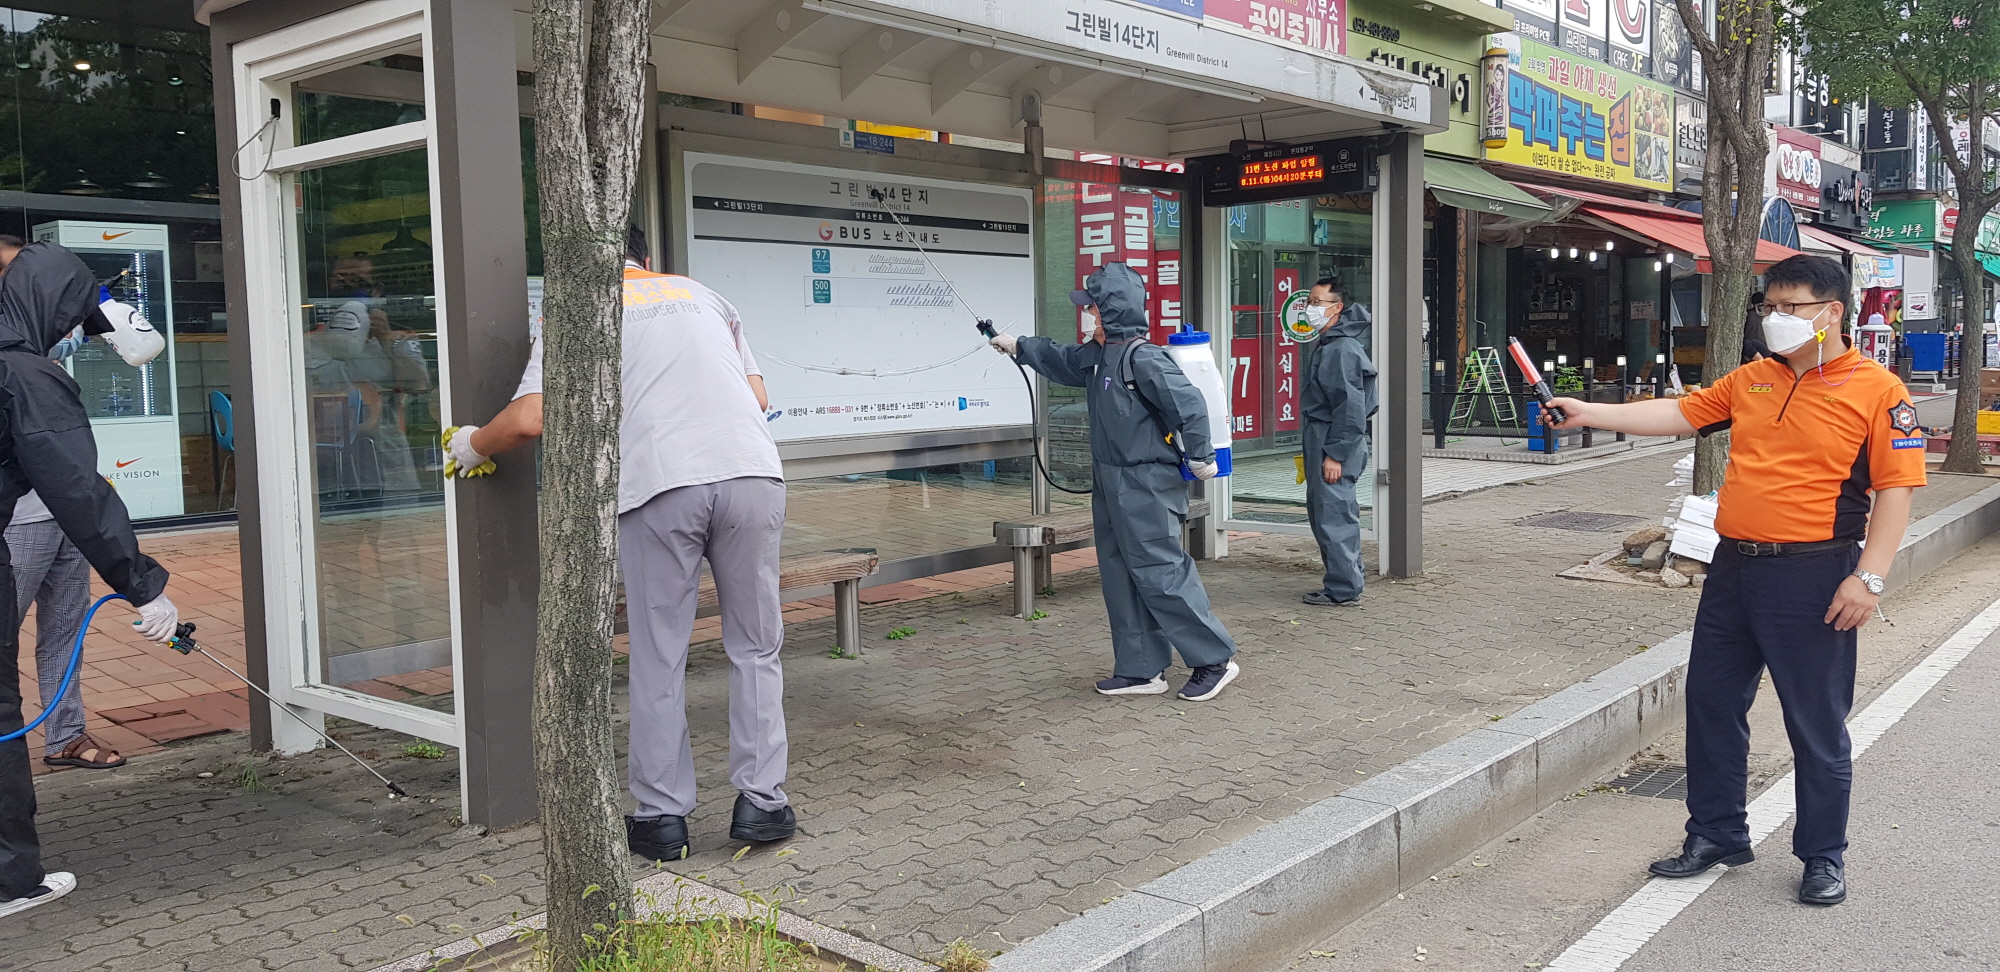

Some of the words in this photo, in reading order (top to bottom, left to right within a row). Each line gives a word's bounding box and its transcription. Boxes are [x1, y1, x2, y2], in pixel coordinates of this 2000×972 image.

[1065, 9, 1159, 55] 그린빌14단지
[1248, 1, 1340, 54] 공인중개사
[1166, 46, 1195, 62] Greenvill
[1197, 54, 1219, 67] District
[1221, 60, 1228, 69] 14
[1613, 49, 1628, 68] CAFE
[1631, 52, 1643, 74] 2F
[1548, 56, 1571, 87] 과일
[1573, 64, 1595, 95] 야채
[1598, 70, 1618, 100] 생선
[1509, 72, 1605, 162] 막퍼주는
[1608, 90, 1631, 167] 집
[1487, 127, 1505, 138] Shop
[868, 135, 894, 149] 18-244
[1245, 164, 1260, 174] 11번
[1264, 162, 1278, 172] 노선
[1281, 160, 1297, 169] 파업
[1551, 154, 1557, 169] 더
[723, 201, 764, 212] 그린빌13단지
[849, 199, 878, 210] Greenvill
[903, 204, 911, 212] 14
[839, 226, 872, 240] BUS
[815, 250, 828, 260] 97
[814, 280, 829, 291] 500
[681, 301, 702, 315] Fire
[787, 407, 808, 417] 이용안내
[815, 406, 826, 415] ARS
[123, 469, 160, 479] VISION
